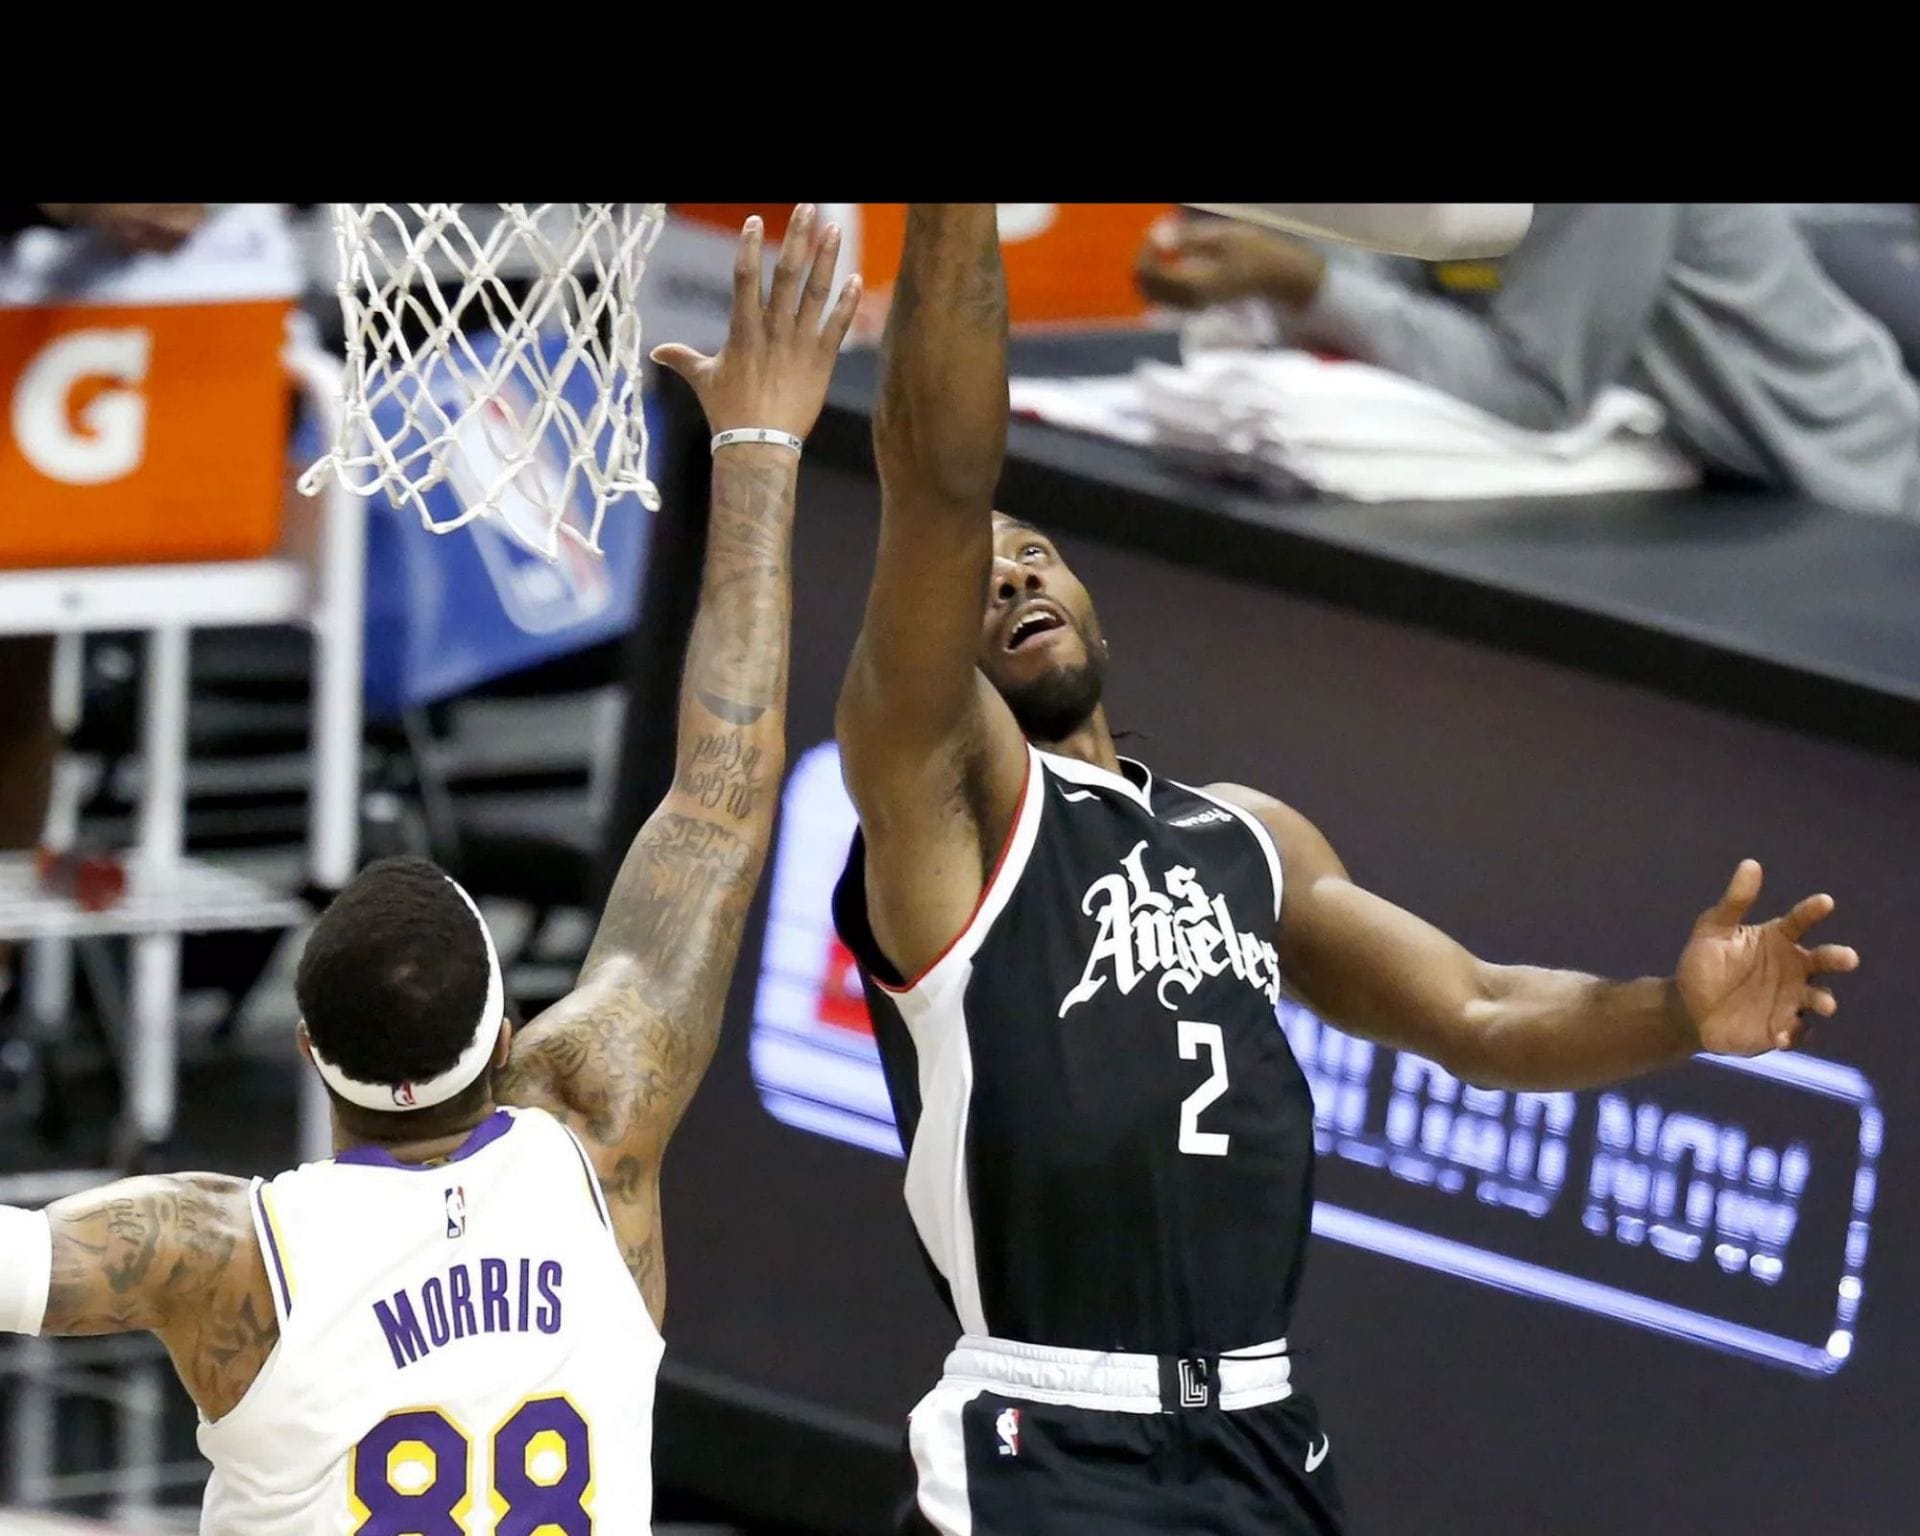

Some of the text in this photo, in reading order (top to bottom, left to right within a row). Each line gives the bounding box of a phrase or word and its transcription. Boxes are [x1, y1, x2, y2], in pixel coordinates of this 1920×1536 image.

[11, 325, 153, 485] G
[1058, 874, 1281, 1018] Angeles
[1177, 1020, 1230, 1156] 2
[1582, 1093, 1811, 1286] NOW
[373, 1258, 562, 1369] MORRIS
[348, 1391, 598, 1536] 88
